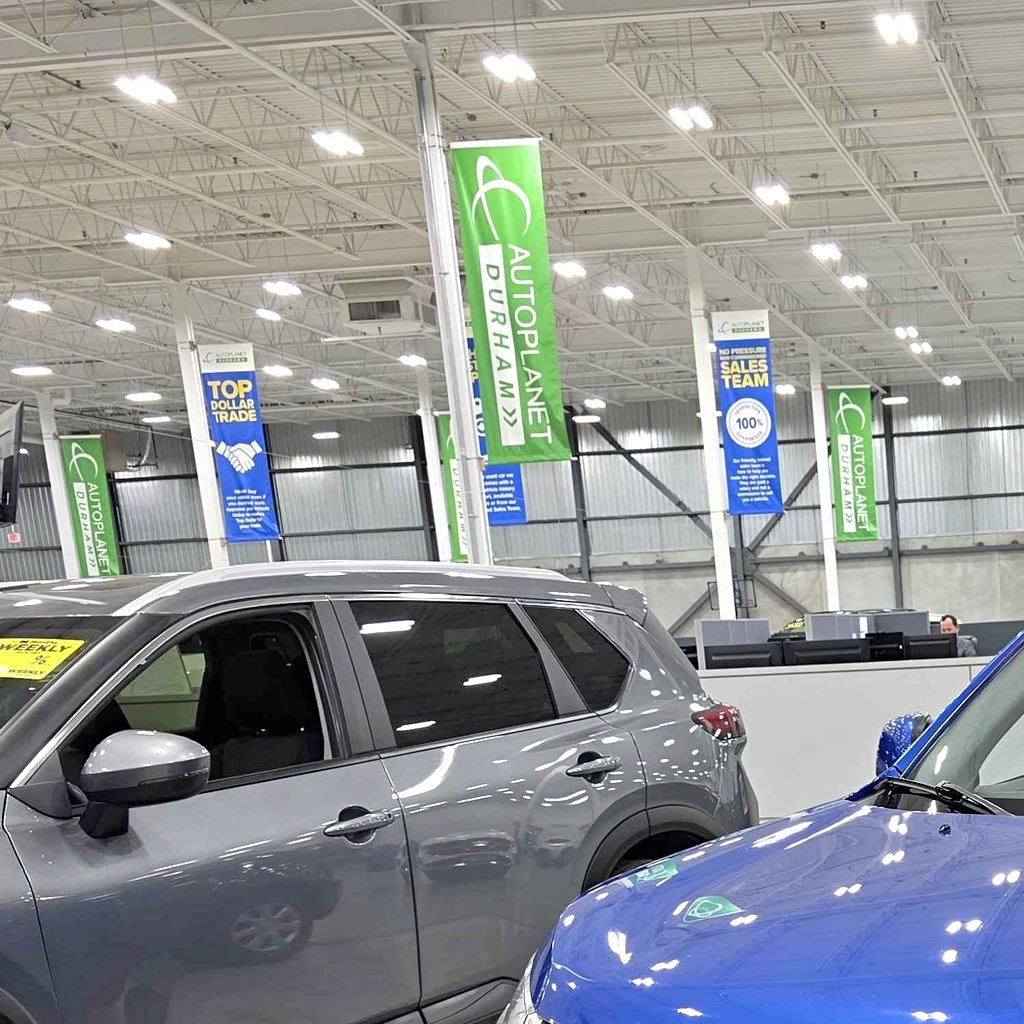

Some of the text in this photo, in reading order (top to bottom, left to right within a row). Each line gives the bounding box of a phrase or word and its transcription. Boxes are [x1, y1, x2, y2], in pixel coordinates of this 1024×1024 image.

[486, 263, 515, 399] DURHAM
[507, 243, 553, 444] AUTOPLANET
[720, 359, 768, 375] SALES
[721, 372, 769, 389] TEAM
[207, 379, 253, 399] TOP
[210, 399, 255, 411] DOLLAR
[212, 409, 257, 423] TRADE
[841, 443, 852, 510] DURHAM
[852, 434, 869, 532] AUTOPLANET
[76, 490, 94, 558] DURHAM
[87, 482, 112, 576] AUTOPLANET
[0, 643, 72, 652] WEEKLY
